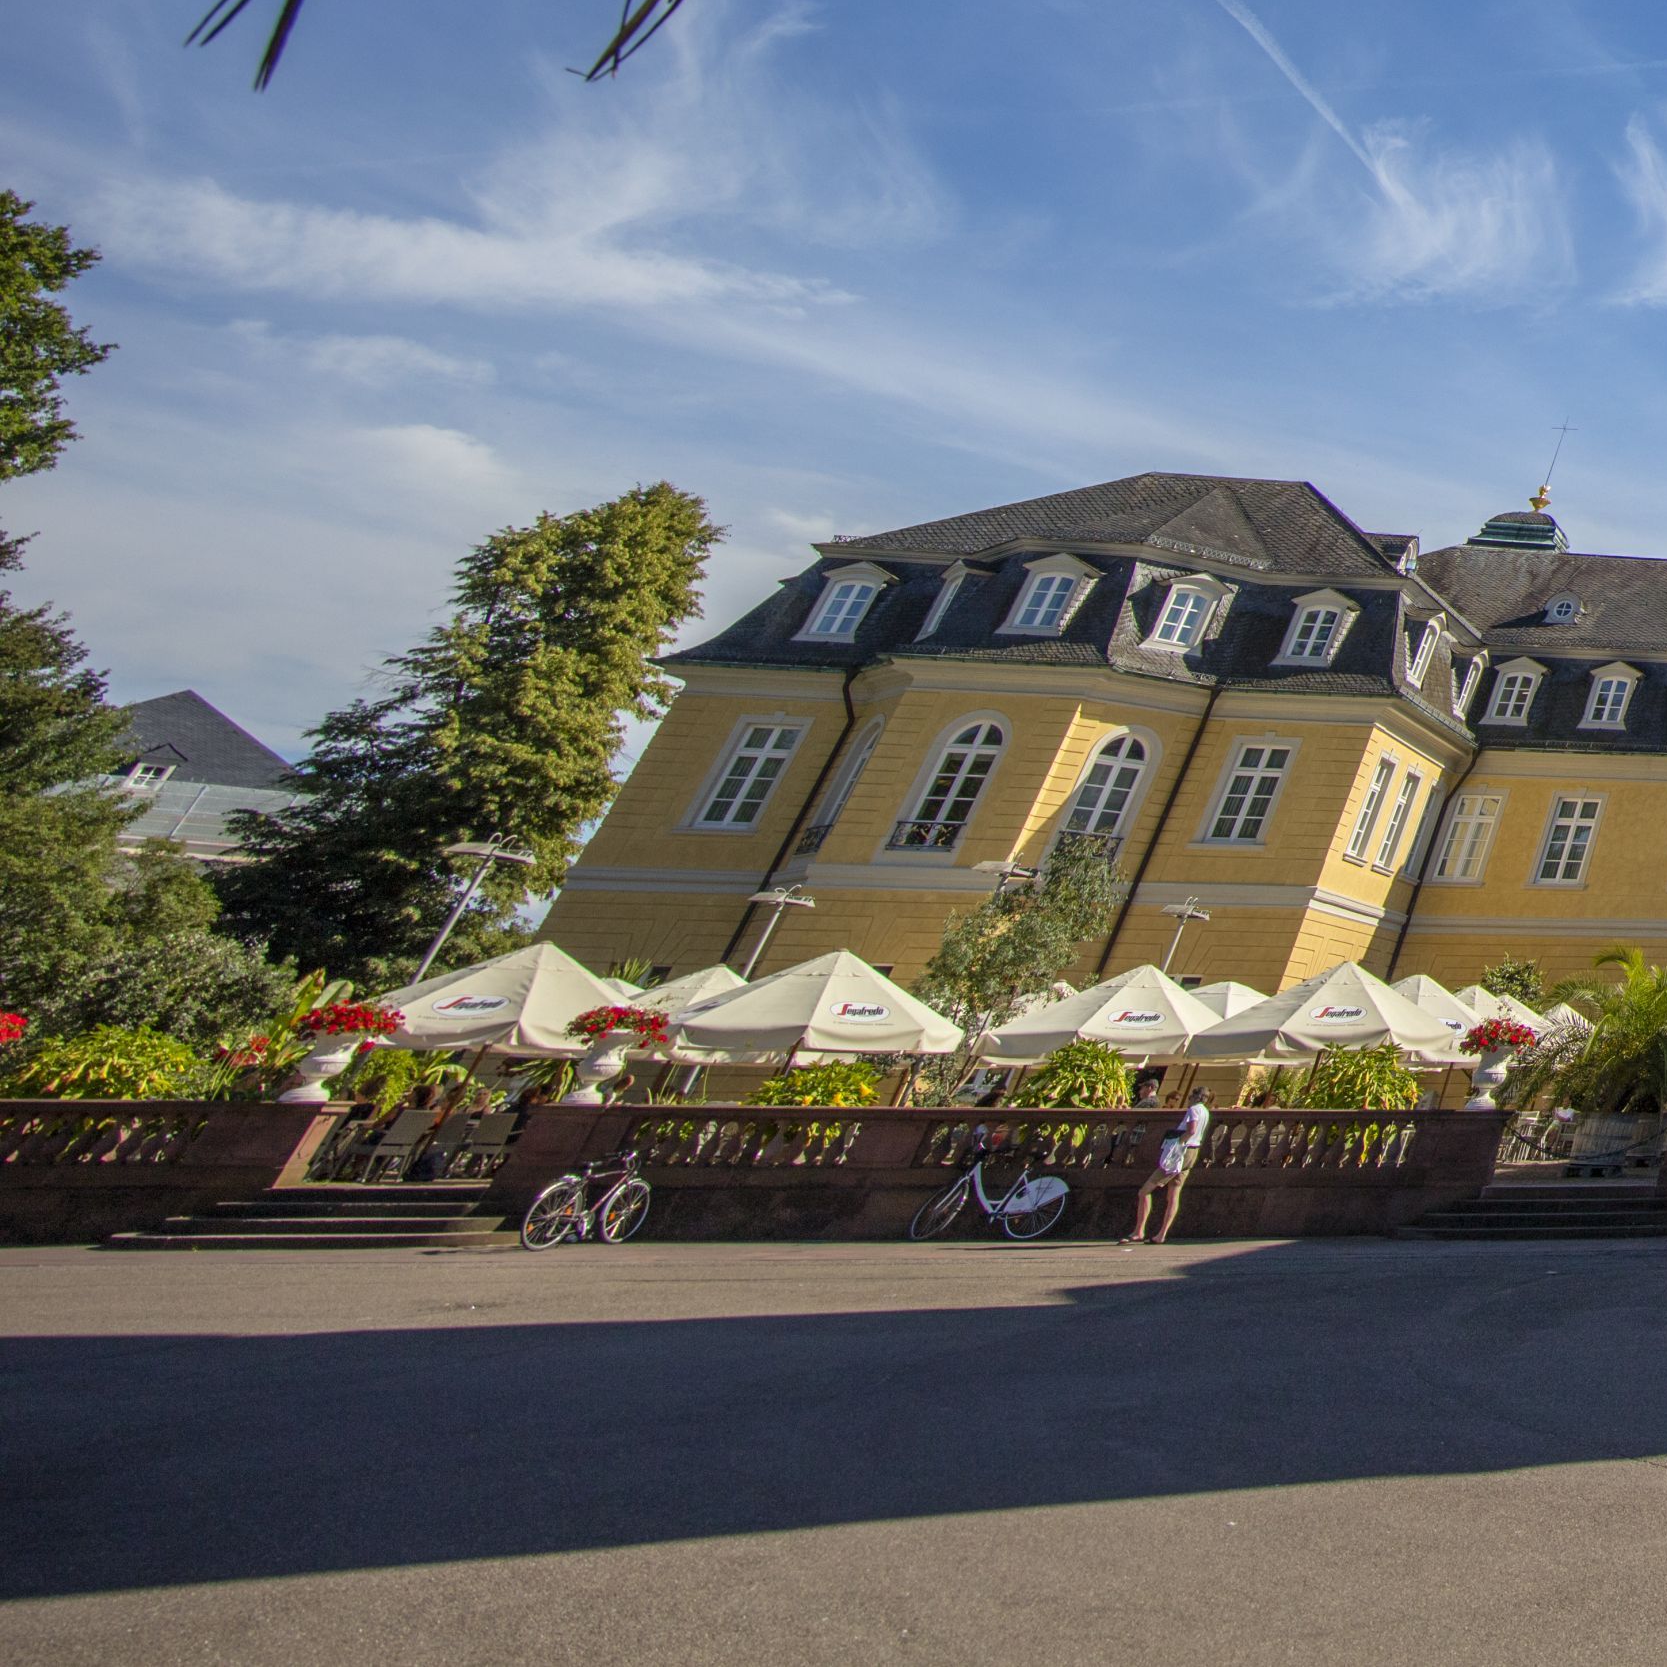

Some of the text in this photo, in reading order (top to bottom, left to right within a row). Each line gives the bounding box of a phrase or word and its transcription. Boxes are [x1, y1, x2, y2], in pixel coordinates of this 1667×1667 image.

[836, 1003, 885, 1017] Segafredo
[1313, 1006, 1363, 1019] Segafredo
[1112, 1011, 1161, 1023] Segafredo
